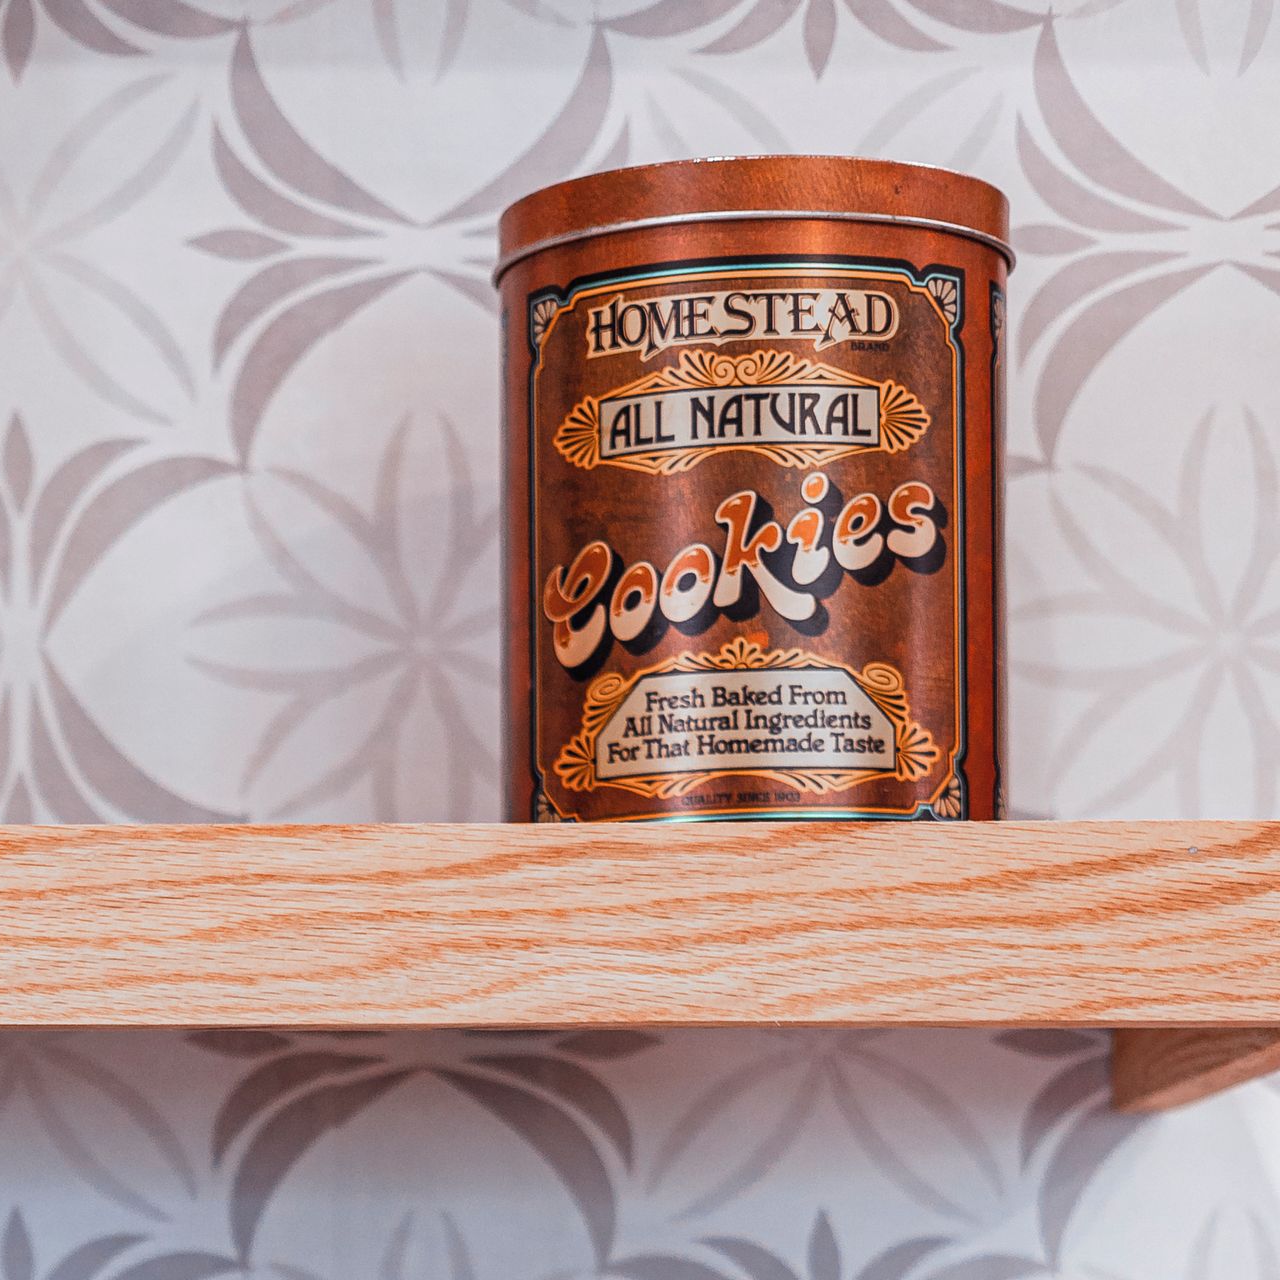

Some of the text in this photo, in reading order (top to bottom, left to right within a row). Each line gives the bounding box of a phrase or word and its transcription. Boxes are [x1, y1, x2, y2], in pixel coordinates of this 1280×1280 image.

[591, 292, 894, 356] HOMESTEAD
[609, 393, 871, 450] ALL NATURAL
[543, 471, 937, 669] Cookies
[645, 685, 847, 712] Fresh Baked From
[623, 709, 872, 738] All Natural Ingredients
[607, 732, 885, 764] For That Homemade Taste
